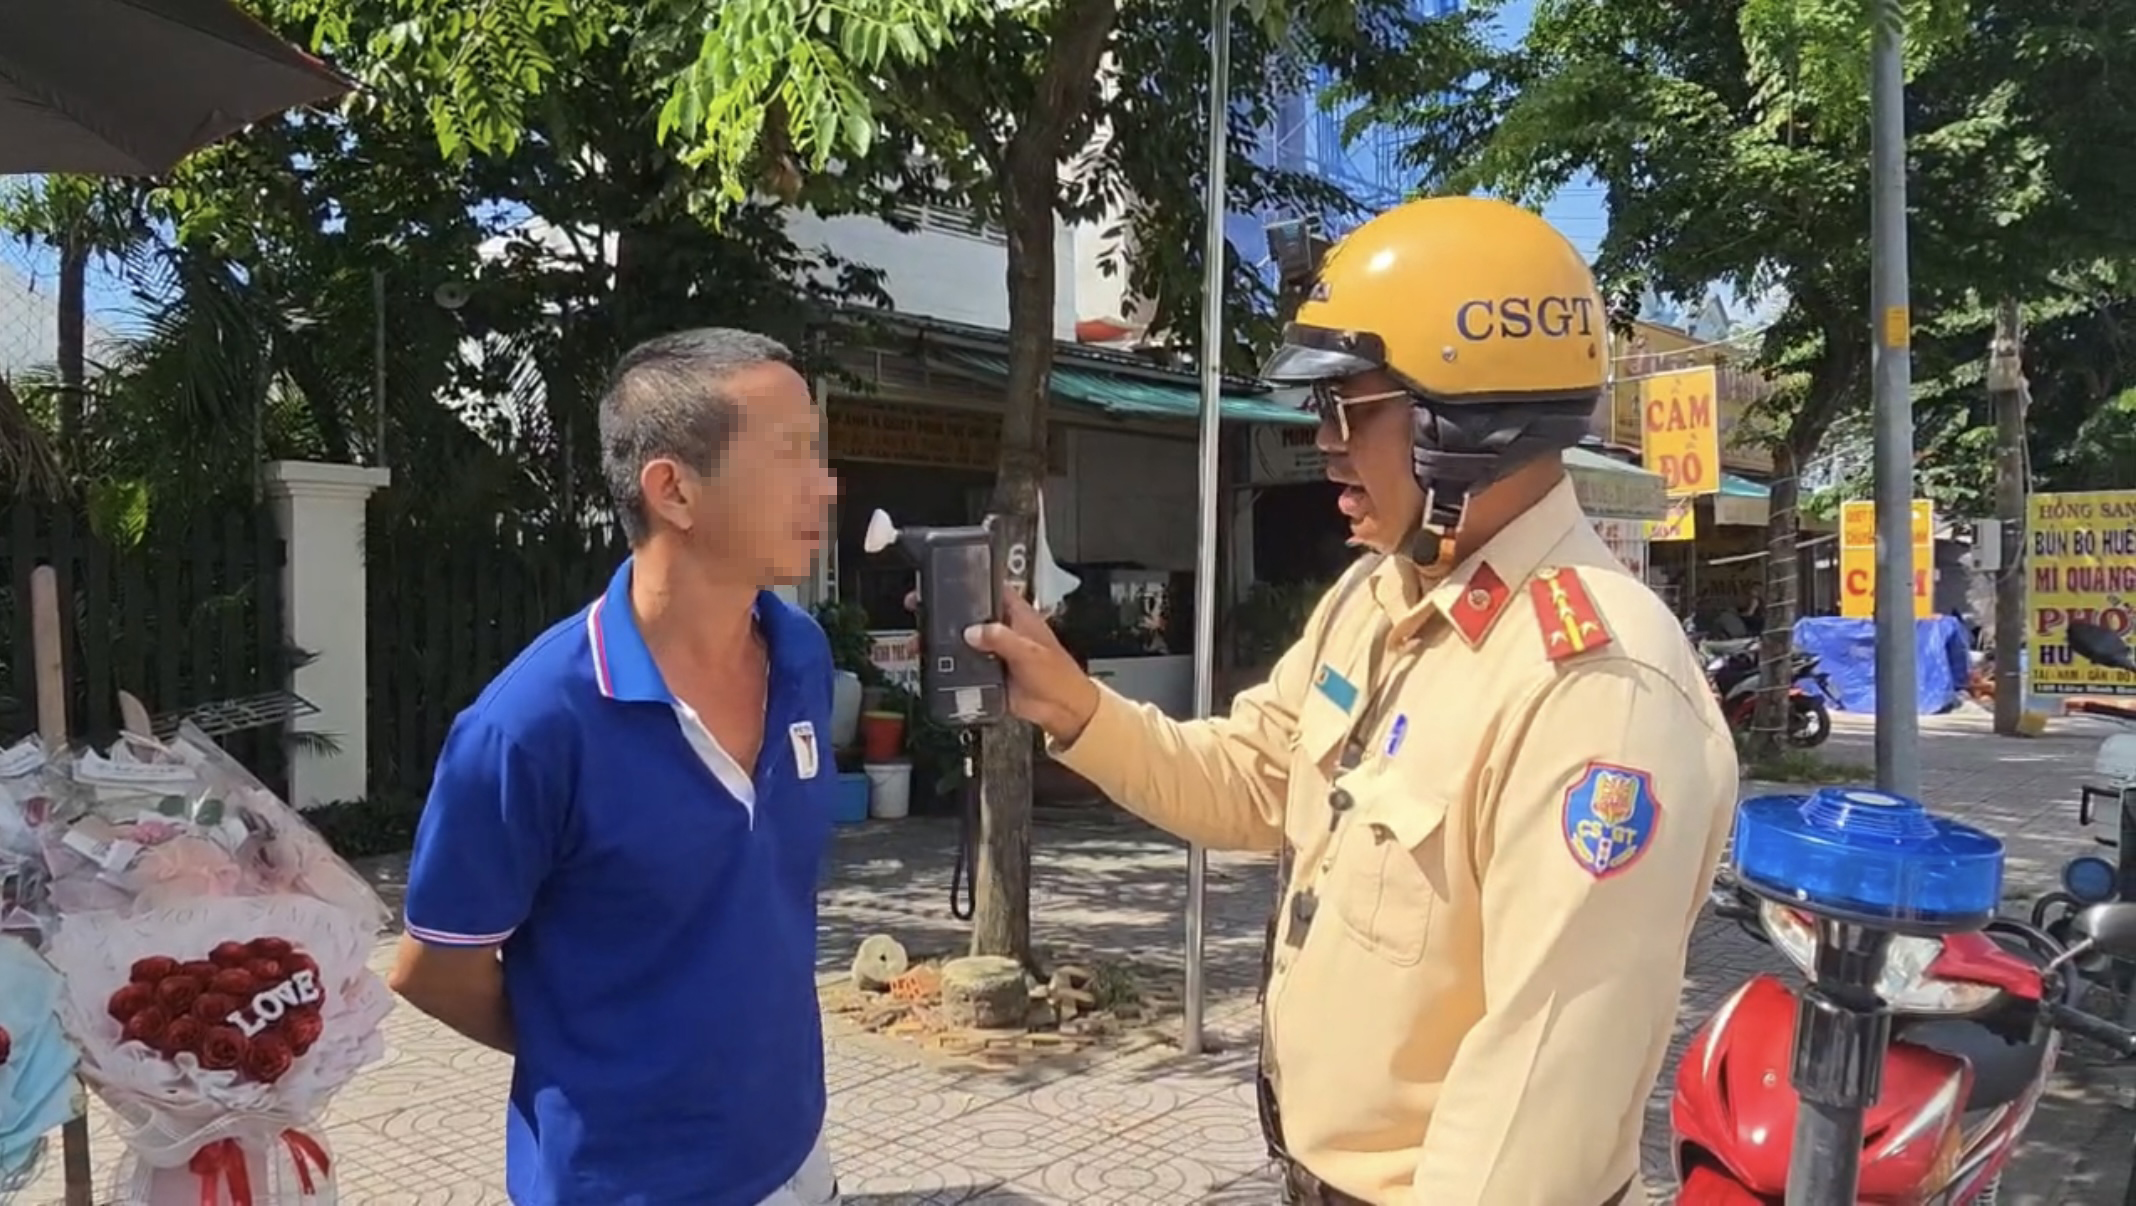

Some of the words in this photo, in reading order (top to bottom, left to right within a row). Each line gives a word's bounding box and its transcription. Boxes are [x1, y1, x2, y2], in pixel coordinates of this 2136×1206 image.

[1456, 296, 1593, 342] CSGT
[1646, 377, 1711, 432] CẦM
[1659, 433, 1703, 488] ĐỒ
[226, 969, 320, 1038] LOVE
